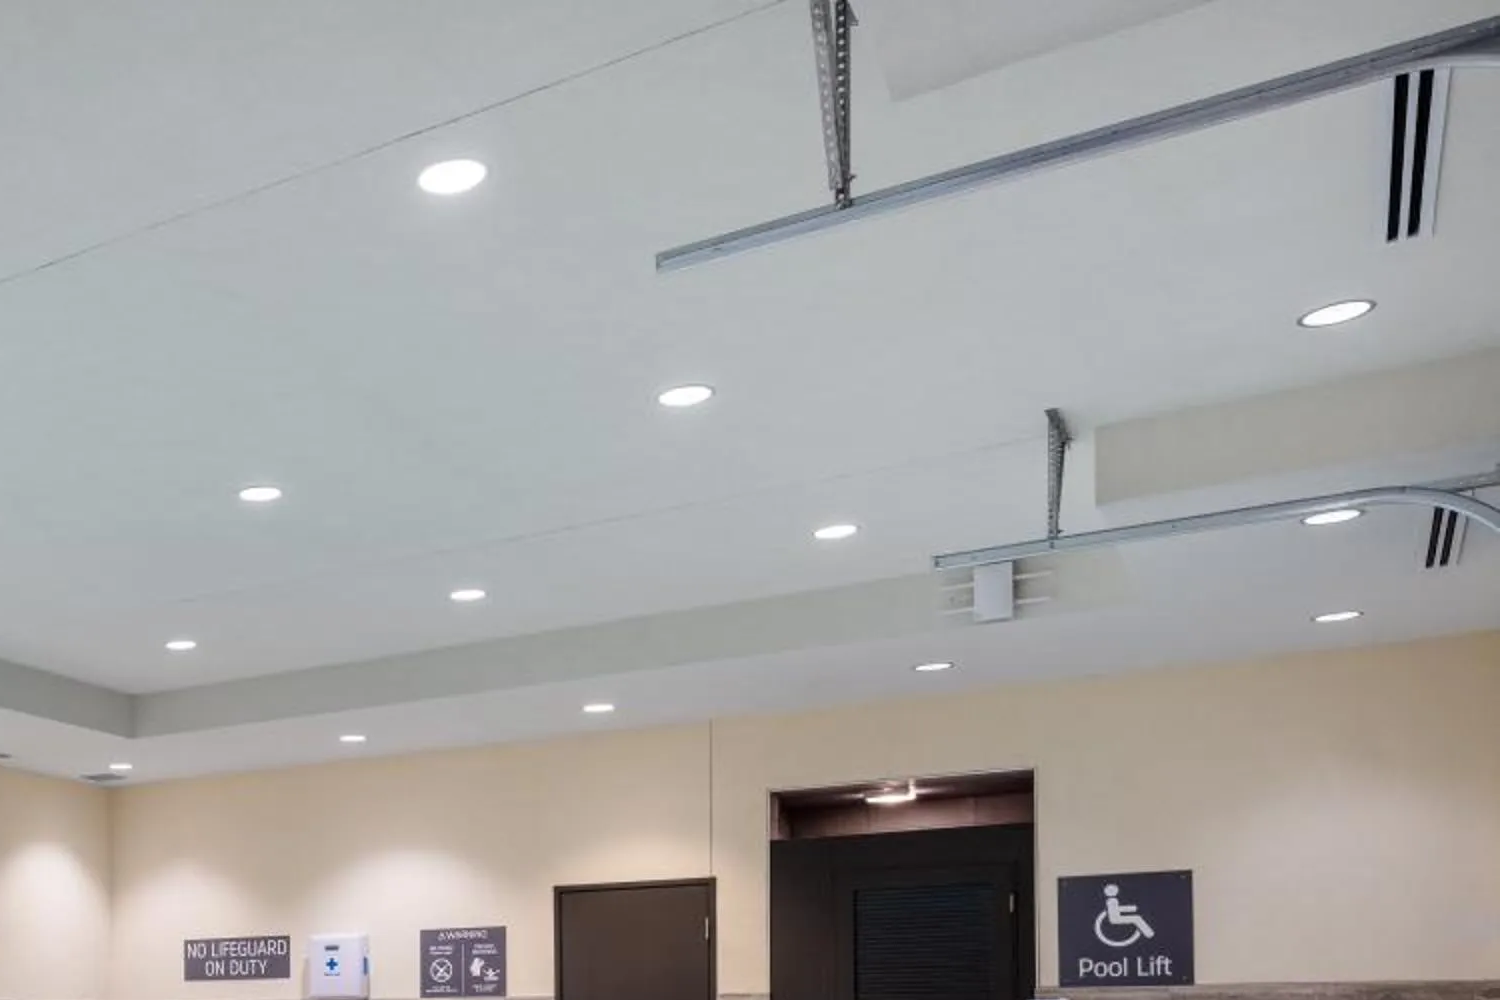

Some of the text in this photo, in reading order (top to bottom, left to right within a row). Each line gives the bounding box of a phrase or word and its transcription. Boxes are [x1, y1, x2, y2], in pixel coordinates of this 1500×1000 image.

[187, 939, 287, 960] NO LIFEGUARD
[205, 959, 268, 976] ON DUTY
[1078, 954, 1174, 978] Pool Lift
